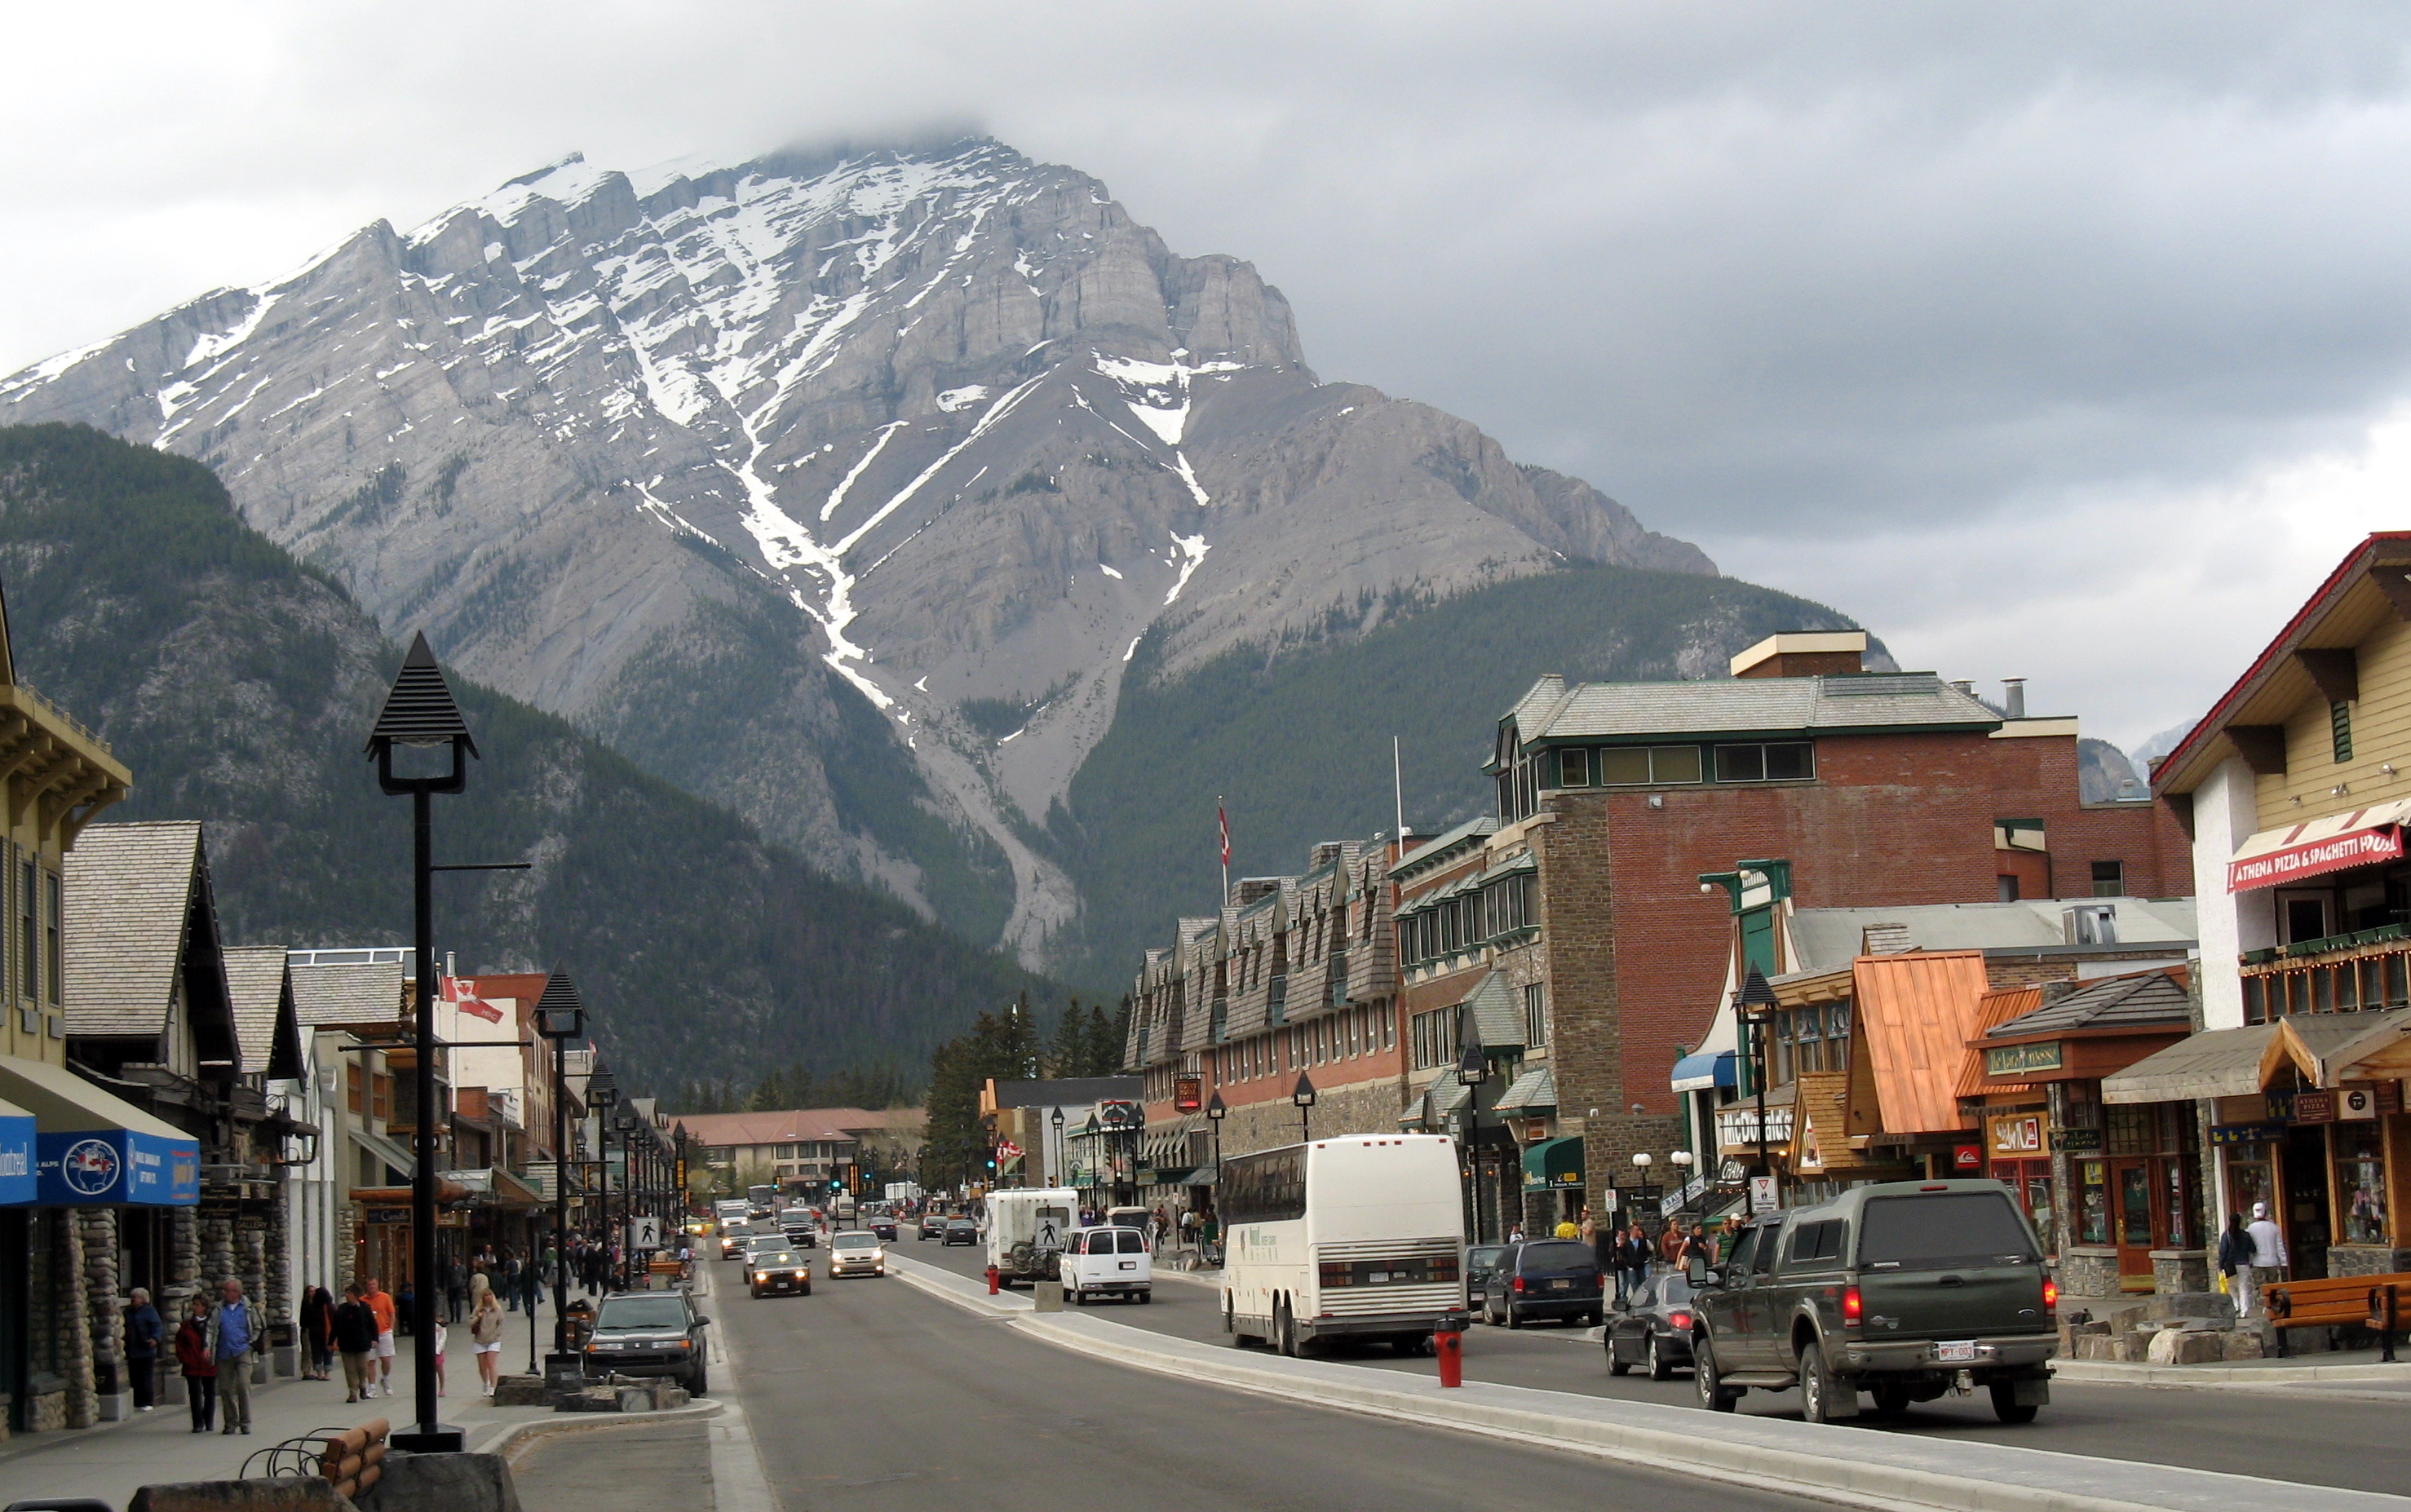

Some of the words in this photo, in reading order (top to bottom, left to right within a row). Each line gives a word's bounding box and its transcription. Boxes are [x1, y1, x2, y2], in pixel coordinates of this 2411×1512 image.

[2236, 859, 2272, 883] ATHENA
[2274, 852, 2300, 873] PIZZA
[2302, 851, 2309, 868] &
[2310, 838, 2358, 864] SPAGHETTI
[1723, 1109, 1793, 1143] McDoald's
[0, 1142, 28, 1176] ontreal
